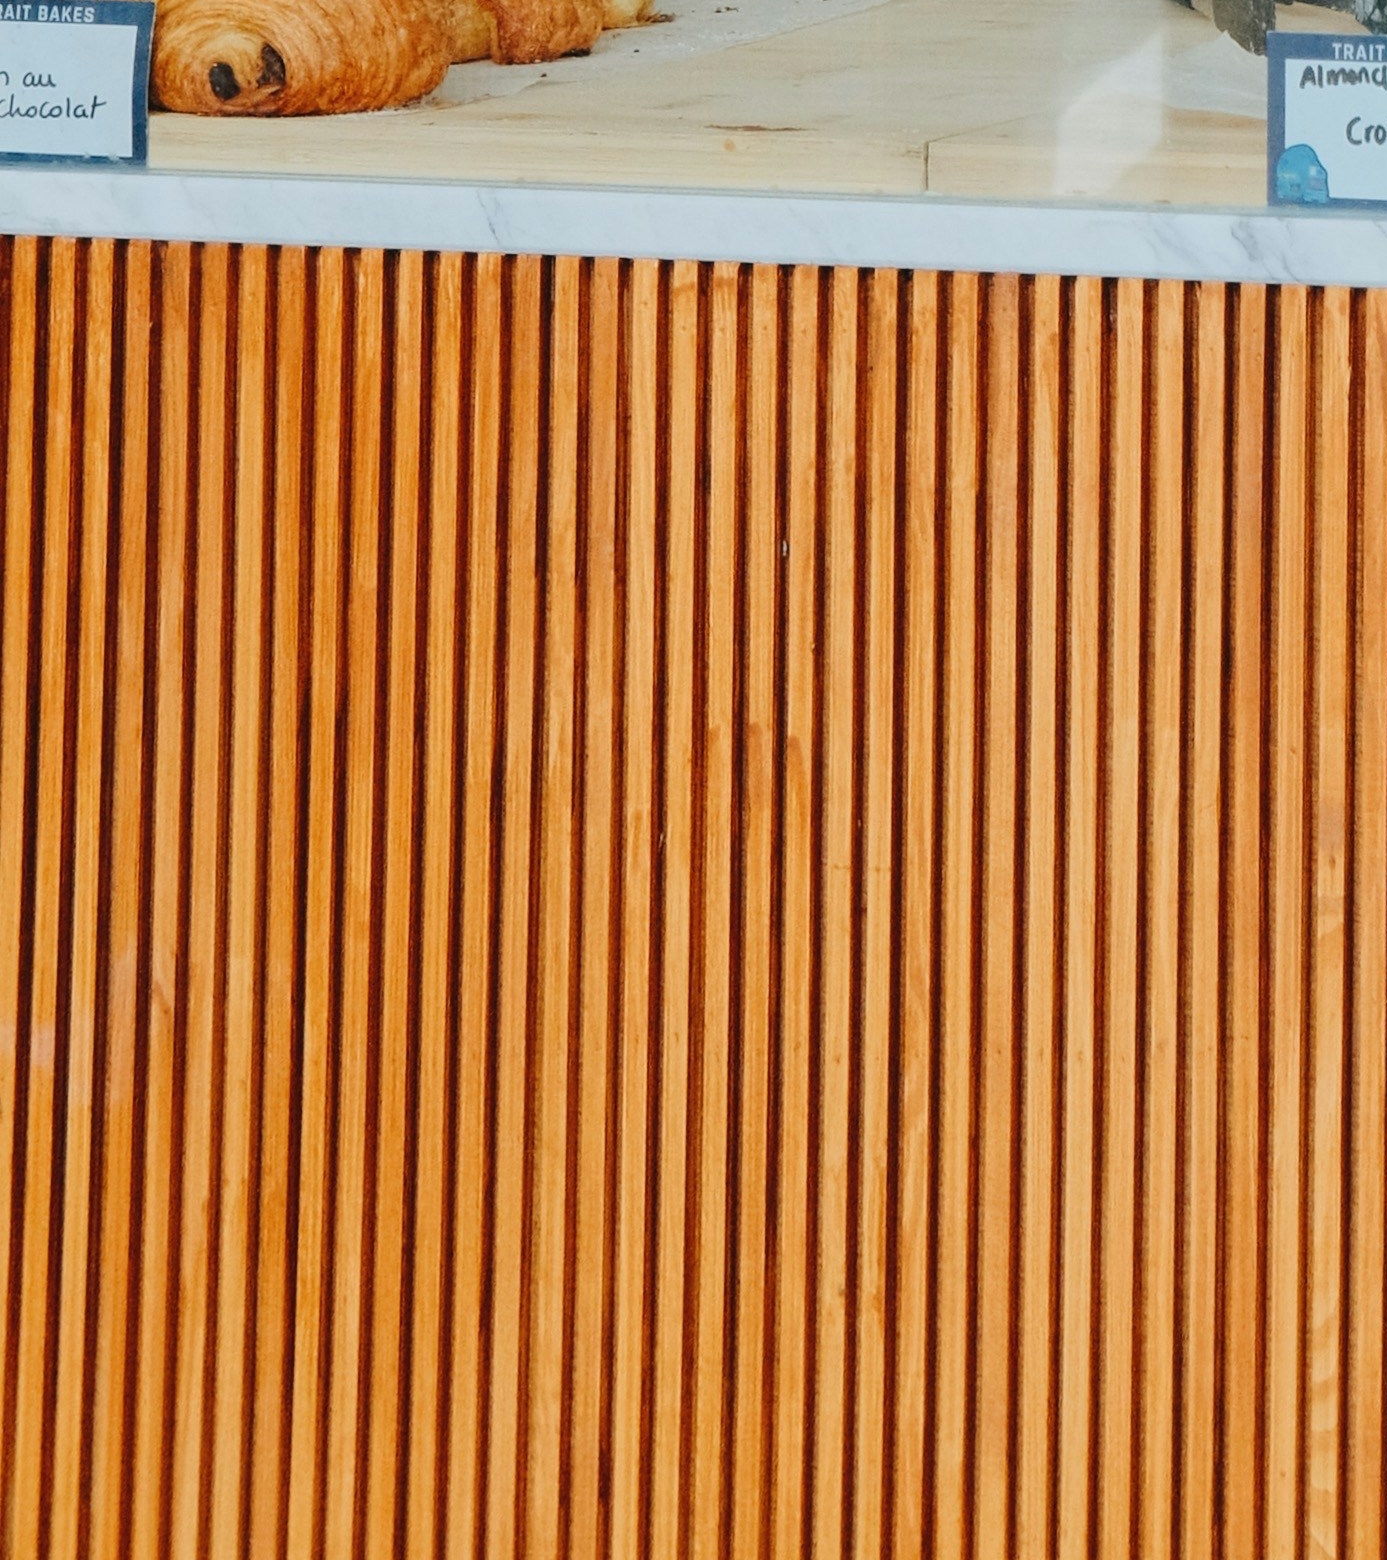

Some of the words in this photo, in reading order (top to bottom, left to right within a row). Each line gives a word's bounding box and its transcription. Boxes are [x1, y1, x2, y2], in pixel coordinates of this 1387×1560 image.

[0, 3, 32, 21] AIT
[38, 4, 95, 23] BAKES
[1331, 42, 1386, 61] TRAIT
[22, 71, 57, 88] au
[1299, 64, 1387, 91] Almond
